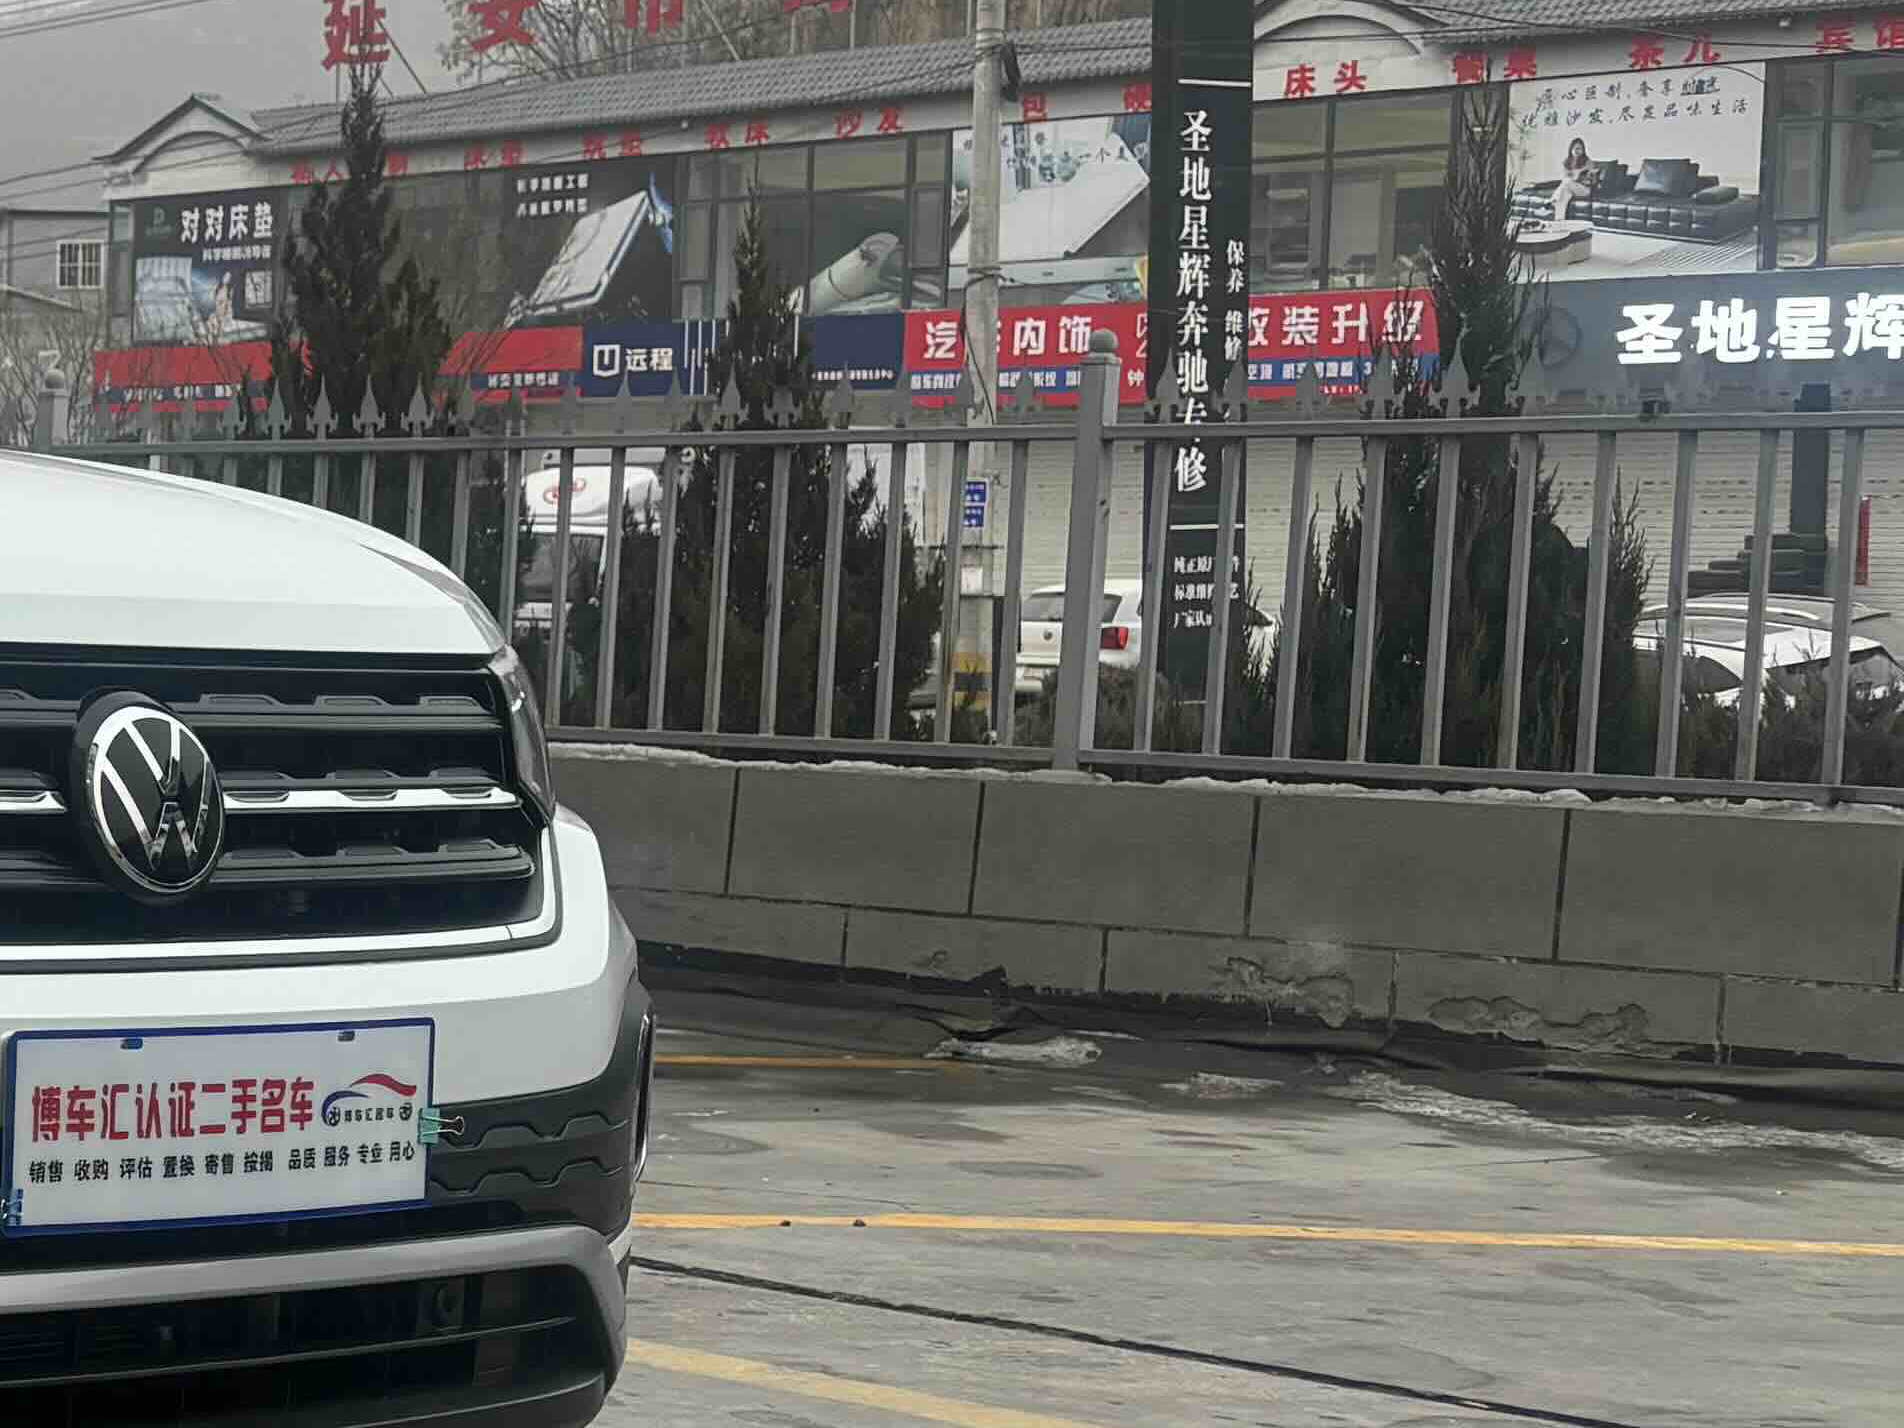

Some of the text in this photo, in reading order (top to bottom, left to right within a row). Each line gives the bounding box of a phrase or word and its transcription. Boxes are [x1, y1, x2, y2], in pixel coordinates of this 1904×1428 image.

[1284, 60, 1367, 99] 床头
[180, 201, 273, 243] 对对床垫
[923, 316, 1091, 360] 汽内饰
[1616, 292, 1904, 365] 圣地星辉
[625, 348, 673, 371] 远程
[31, 1076, 314, 1143] 博车汇认证二手名车
[28, 1160, 63, 1183] 销售
[74, 1158, 109, 1181] 收购
[119, 1156, 153, 1180] 评估
[288, 1147, 316, 1170] 品质
[324, 1145, 350, 1167] 服务
[357, 1142, 383, 1164] 专业
[389, 1140, 415, 1162] 用心
